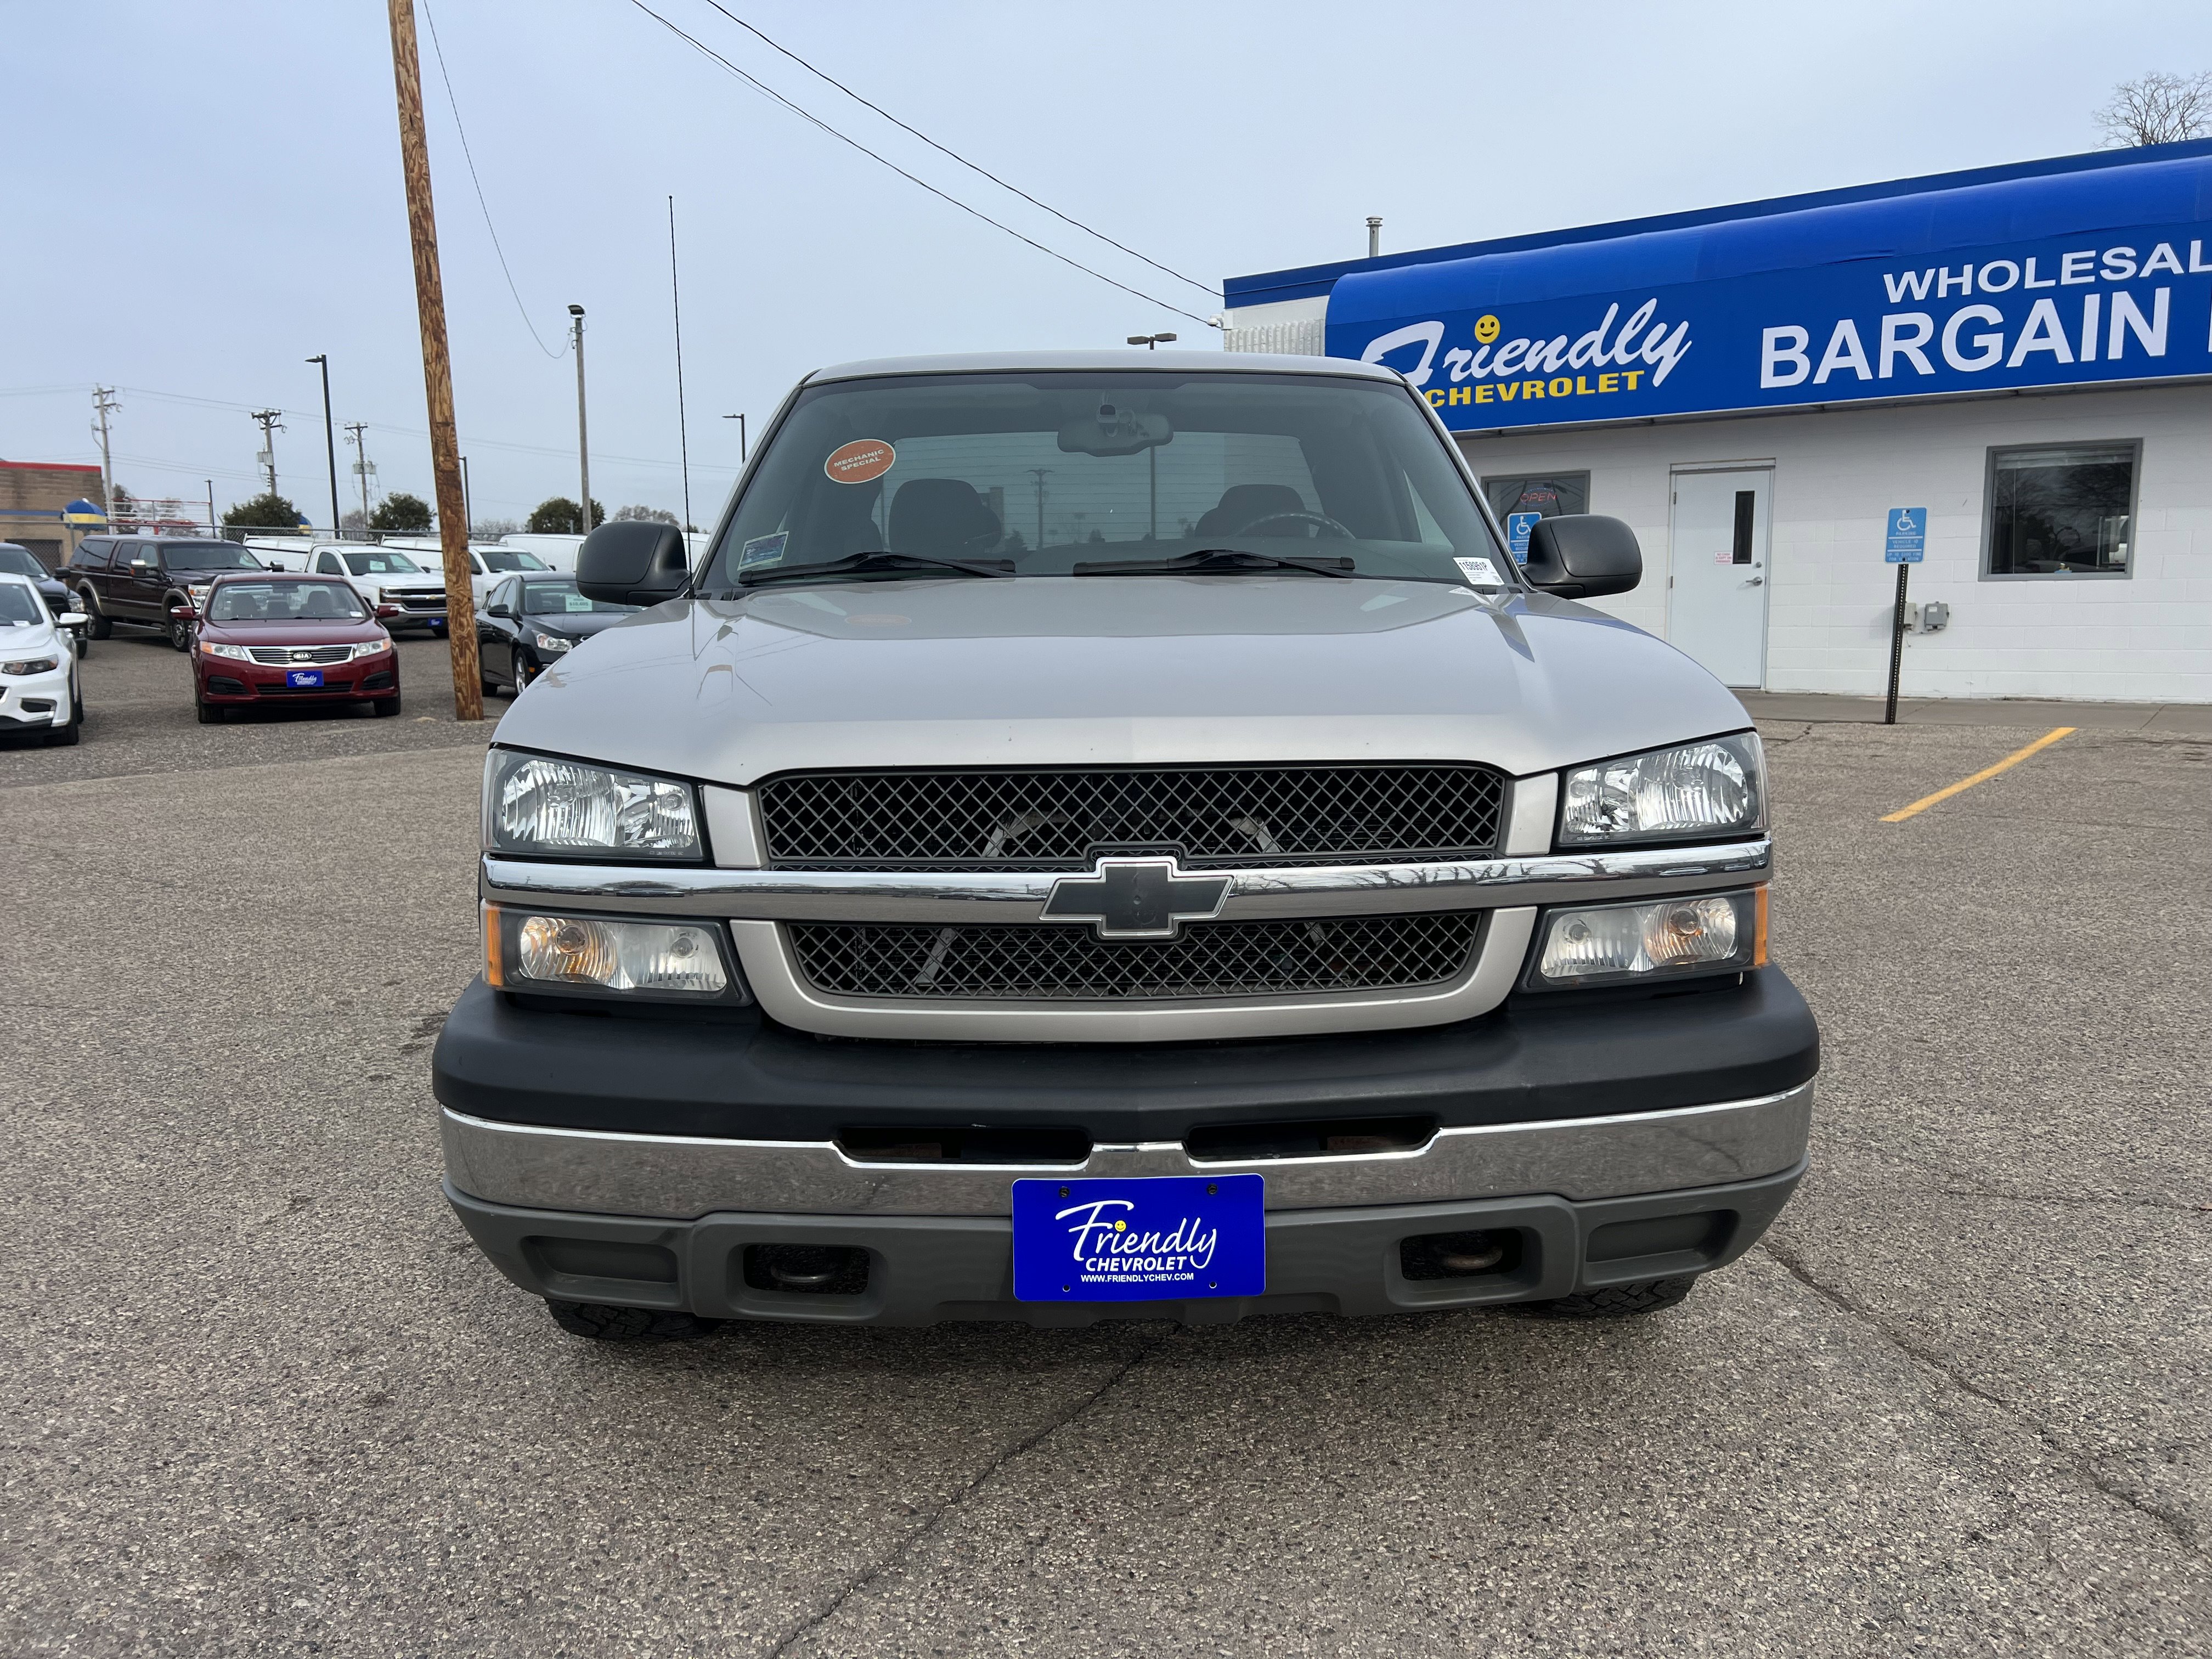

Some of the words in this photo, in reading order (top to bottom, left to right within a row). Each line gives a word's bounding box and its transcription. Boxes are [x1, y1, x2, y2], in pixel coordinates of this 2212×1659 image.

[1883, 239, 2212, 303] WHOLESAL
[1361, 298, 1692, 387] Friendly
[1760, 286, 2171, 389] BARGAIN
[1424, 370, 1645, 408] CHEVROLET
[833, 449, 884, 467] MECHANIC
[841, 456, 881, 471] SPECIAL
[1520, 492, 1557, 501] OPEN
[1055, 1200, 1217, 1269] Friendly
[1081, 1272, 1194, 1283] WWW.FRIENDLYCHEV.COM
[1085, 1256, 1187, 1272] CHEVROLET
